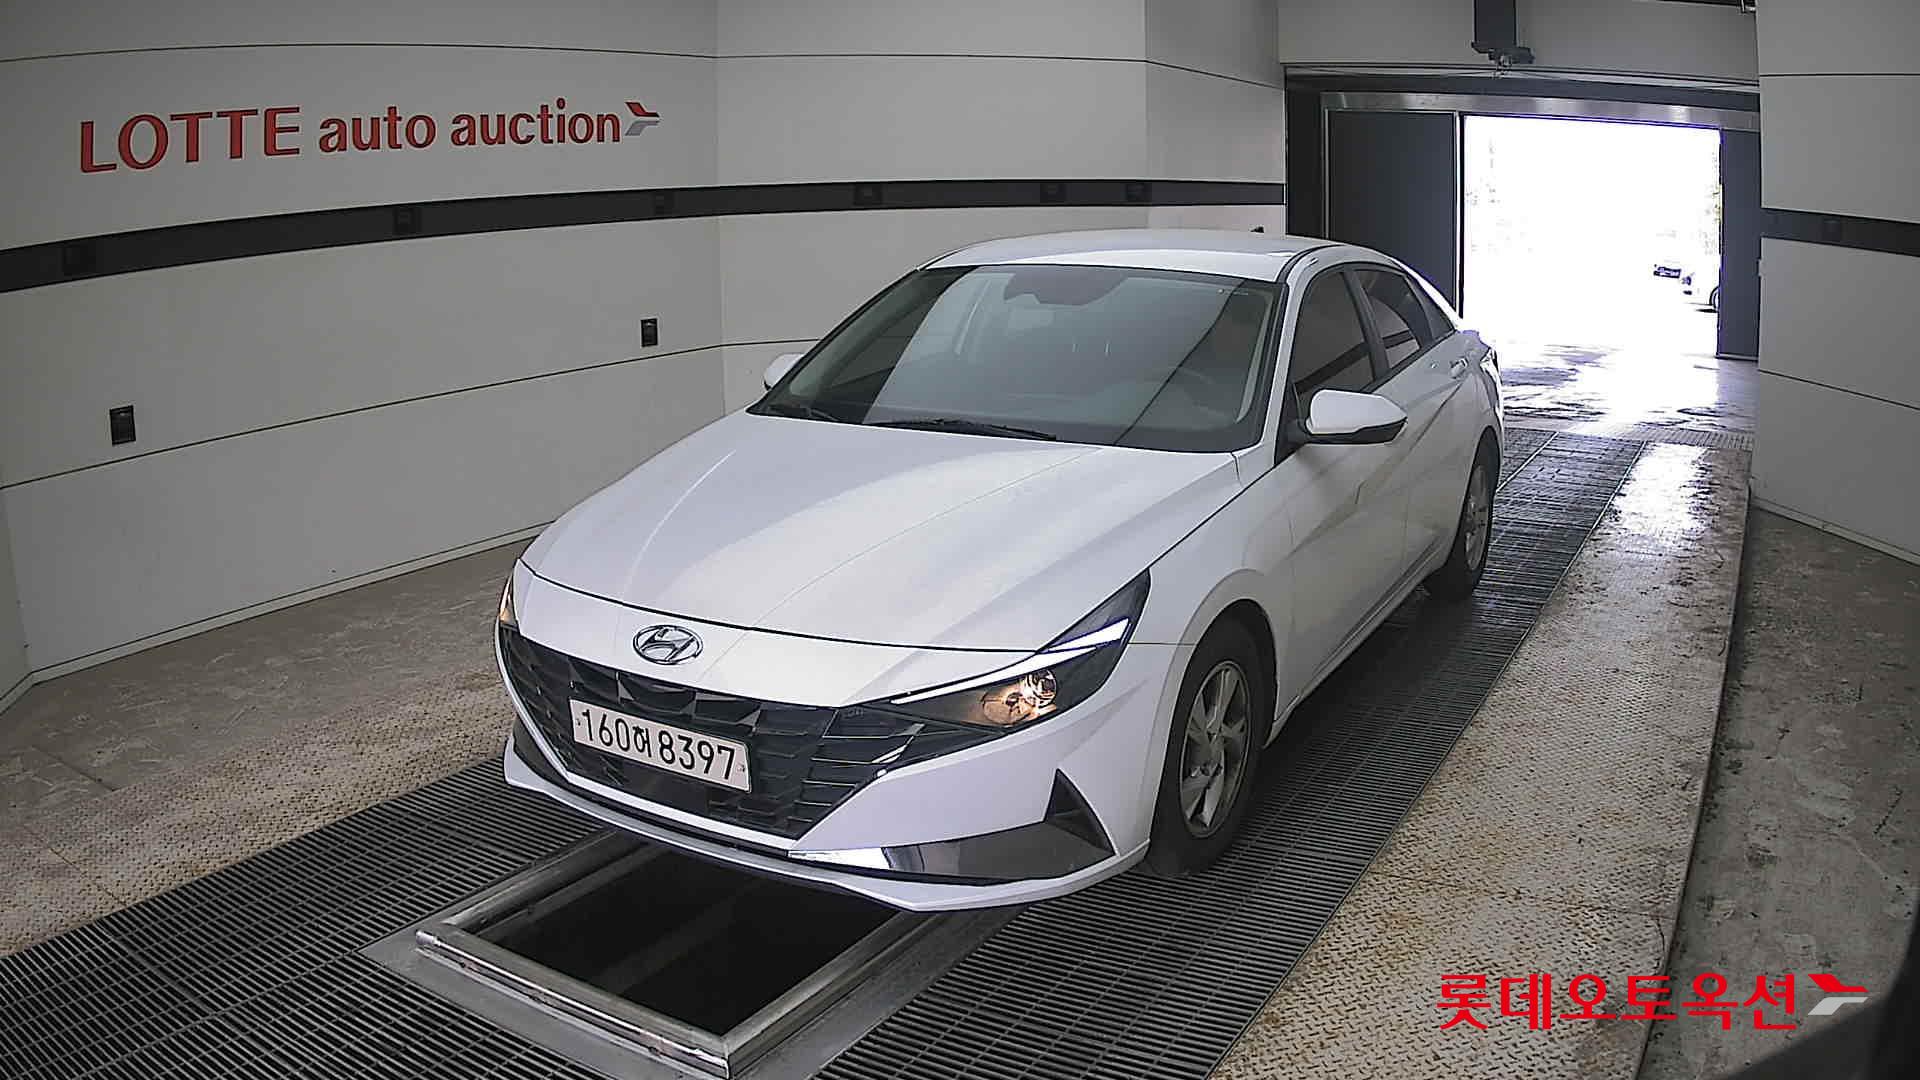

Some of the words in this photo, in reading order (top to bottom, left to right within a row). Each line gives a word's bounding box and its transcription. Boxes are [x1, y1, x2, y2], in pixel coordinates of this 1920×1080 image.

[80, 106, 300, 173] LOTTE
[318, 105, 436, 153] auto
[450, 98, 621, 147] auction
